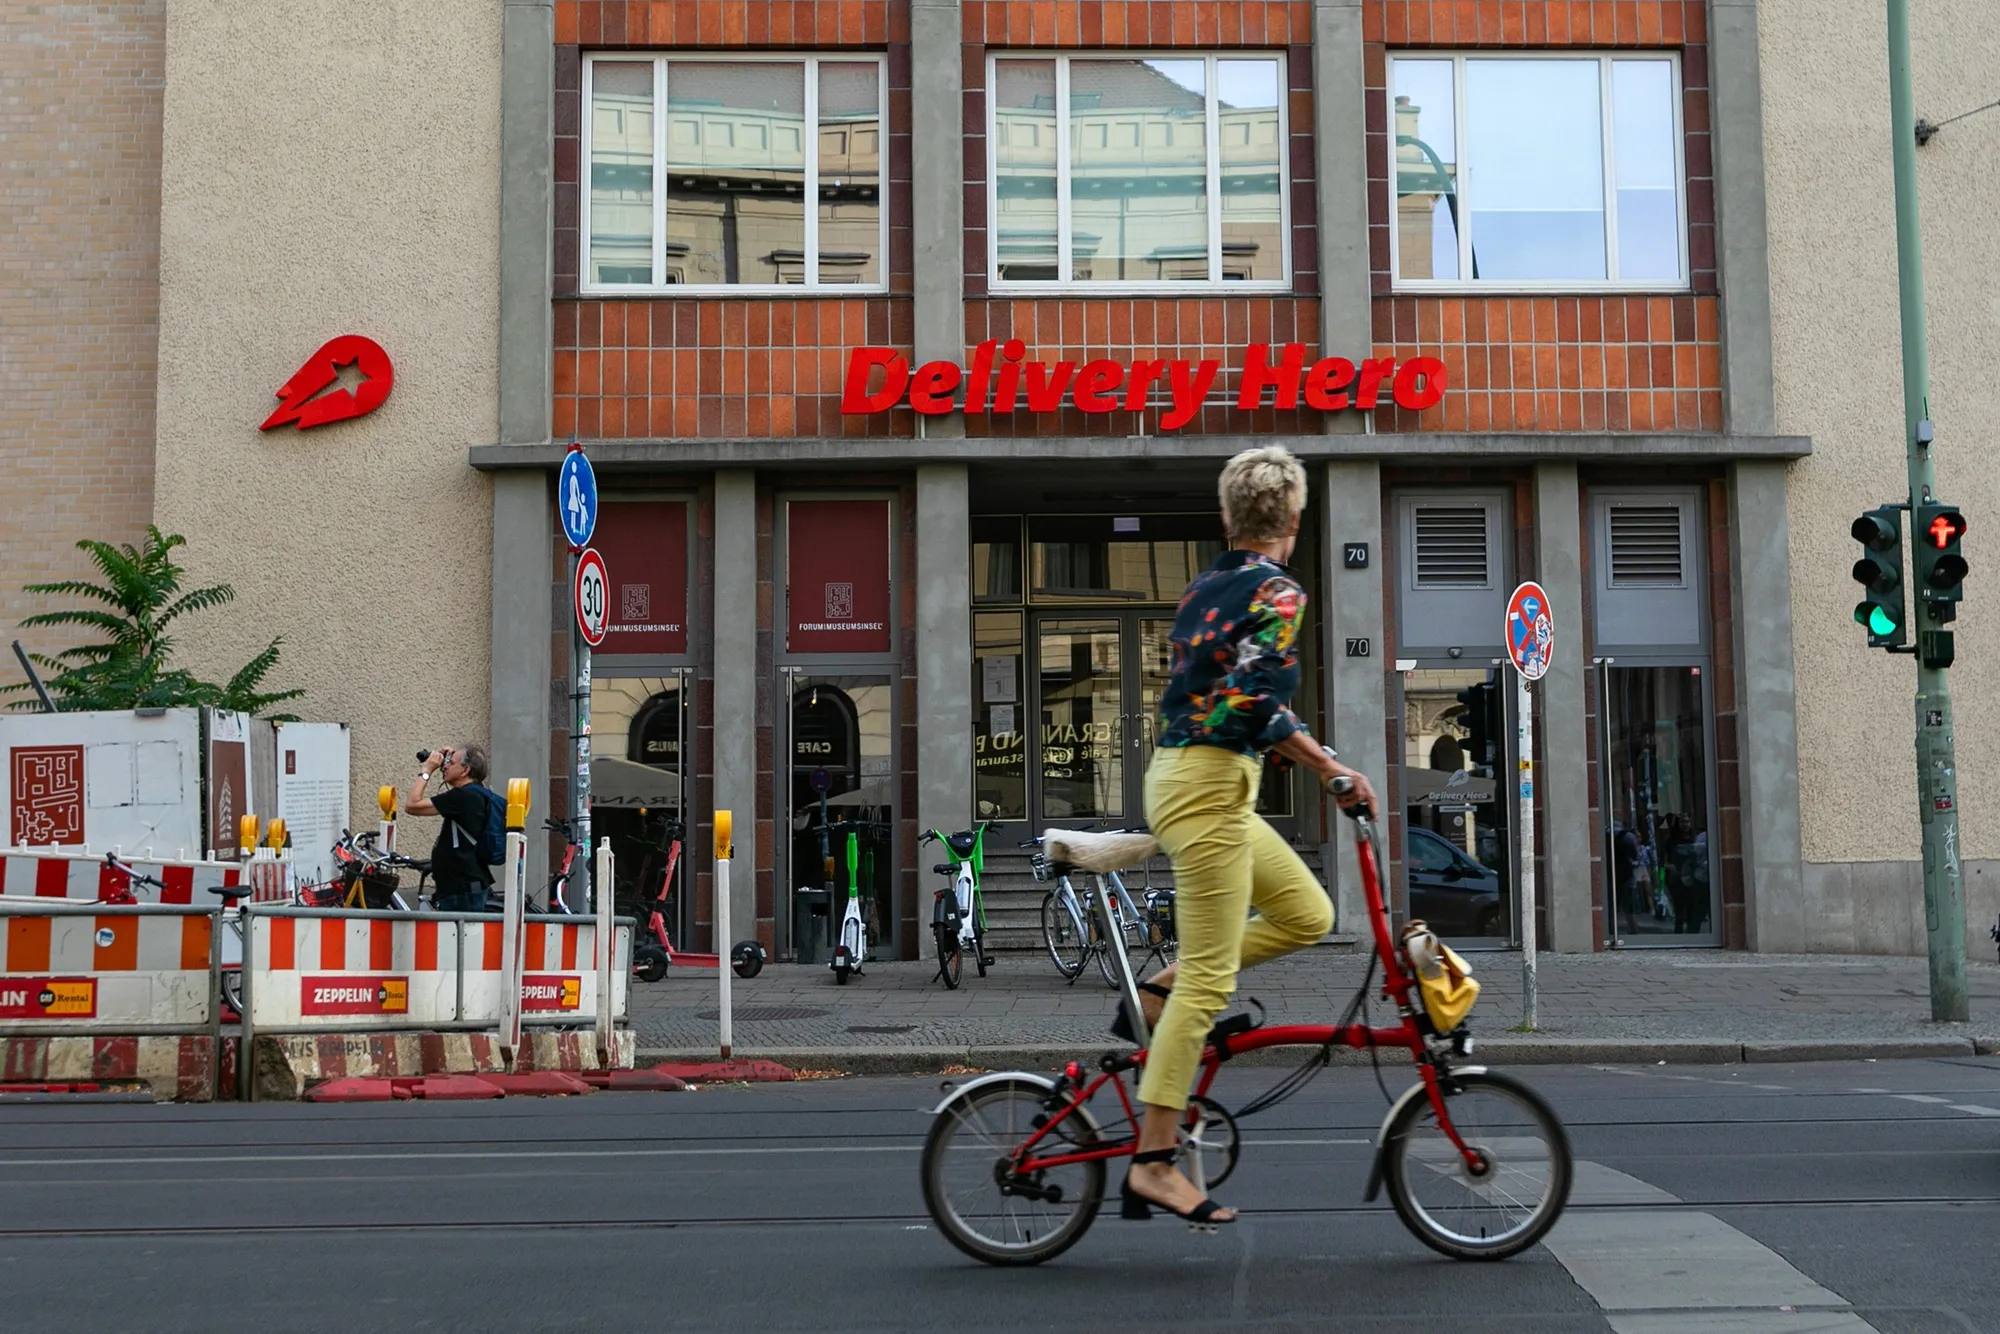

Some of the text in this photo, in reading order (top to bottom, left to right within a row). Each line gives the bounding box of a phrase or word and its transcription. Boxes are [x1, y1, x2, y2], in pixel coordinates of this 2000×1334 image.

[841, 338, 1448, 430] Delivery Hero
[1348, 548, 1366, 562] 70
[583, 575, 603, 618] 30
[1347, 639, 1369, 655] 70
[1428, 791, 1488, 800] Delivery Hero
[0, 990, 28, 1006] IN
[57, 994, 89, 1002] Rental
[314, 988, 373, 1003] ZEPPELIN
[520, 986, 557, 999] EPPELIN
